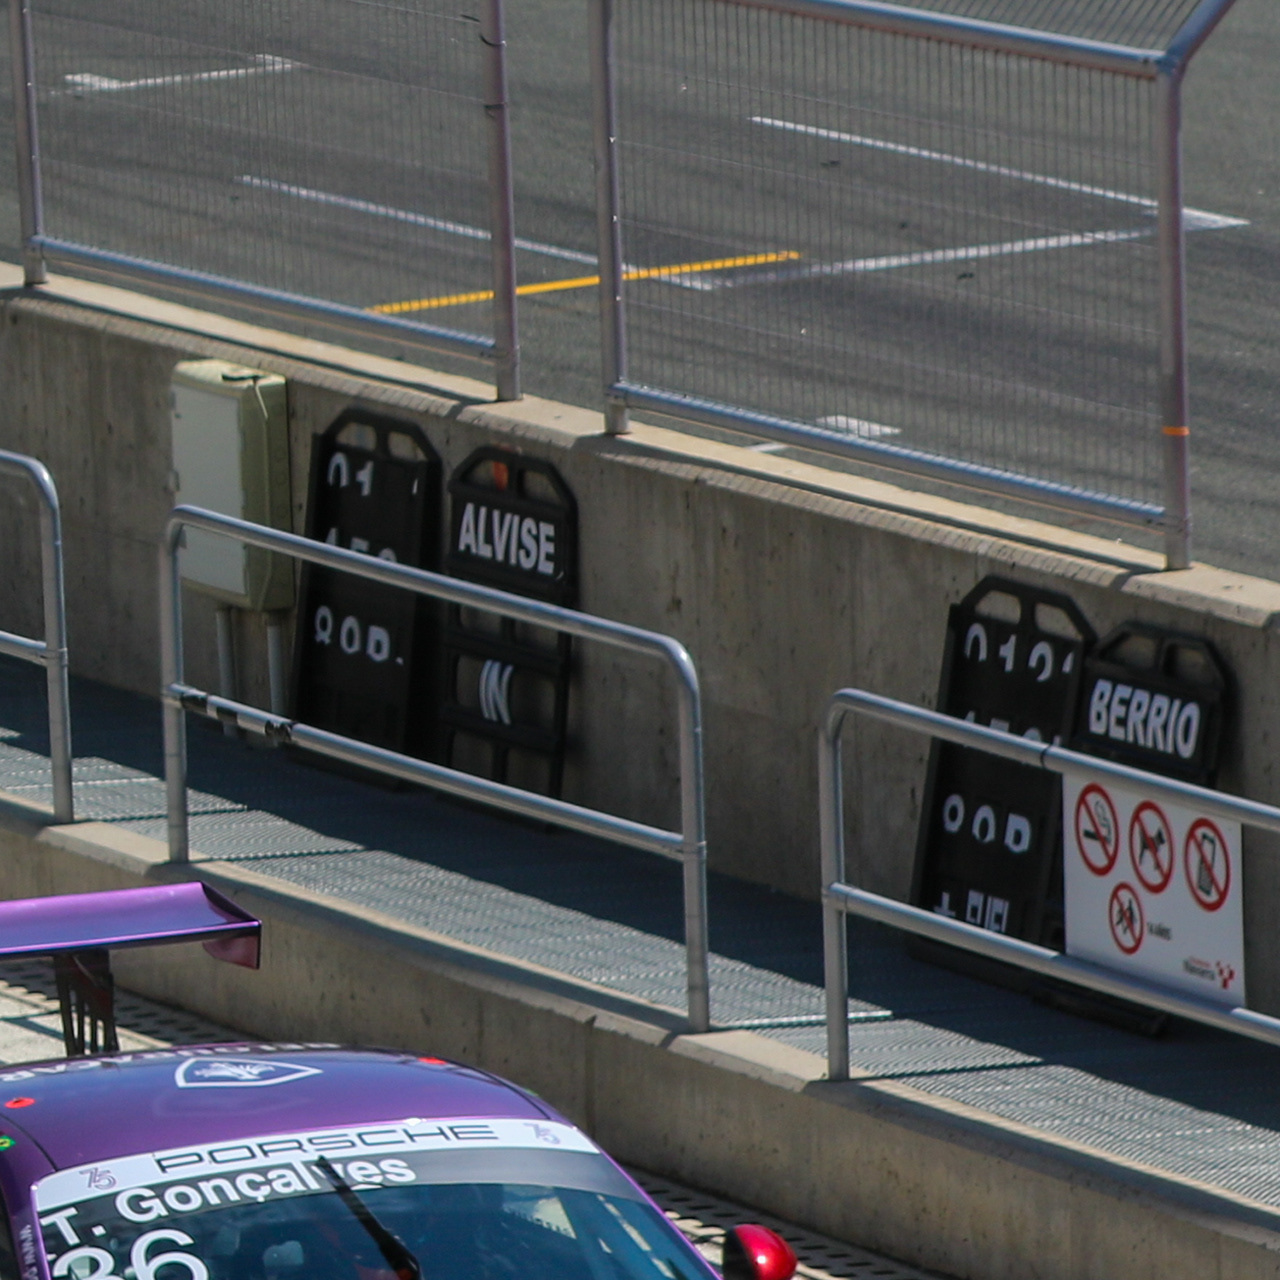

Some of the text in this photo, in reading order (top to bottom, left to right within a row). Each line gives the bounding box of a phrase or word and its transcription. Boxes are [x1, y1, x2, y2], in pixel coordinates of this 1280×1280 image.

[458, 502, 556, 575] ALVISE
[1088, 678, 1201, 759] BERRIO
[154, 1124, 500, 1175] PORSCHE
[40, 1206, 107, 1247] T.
